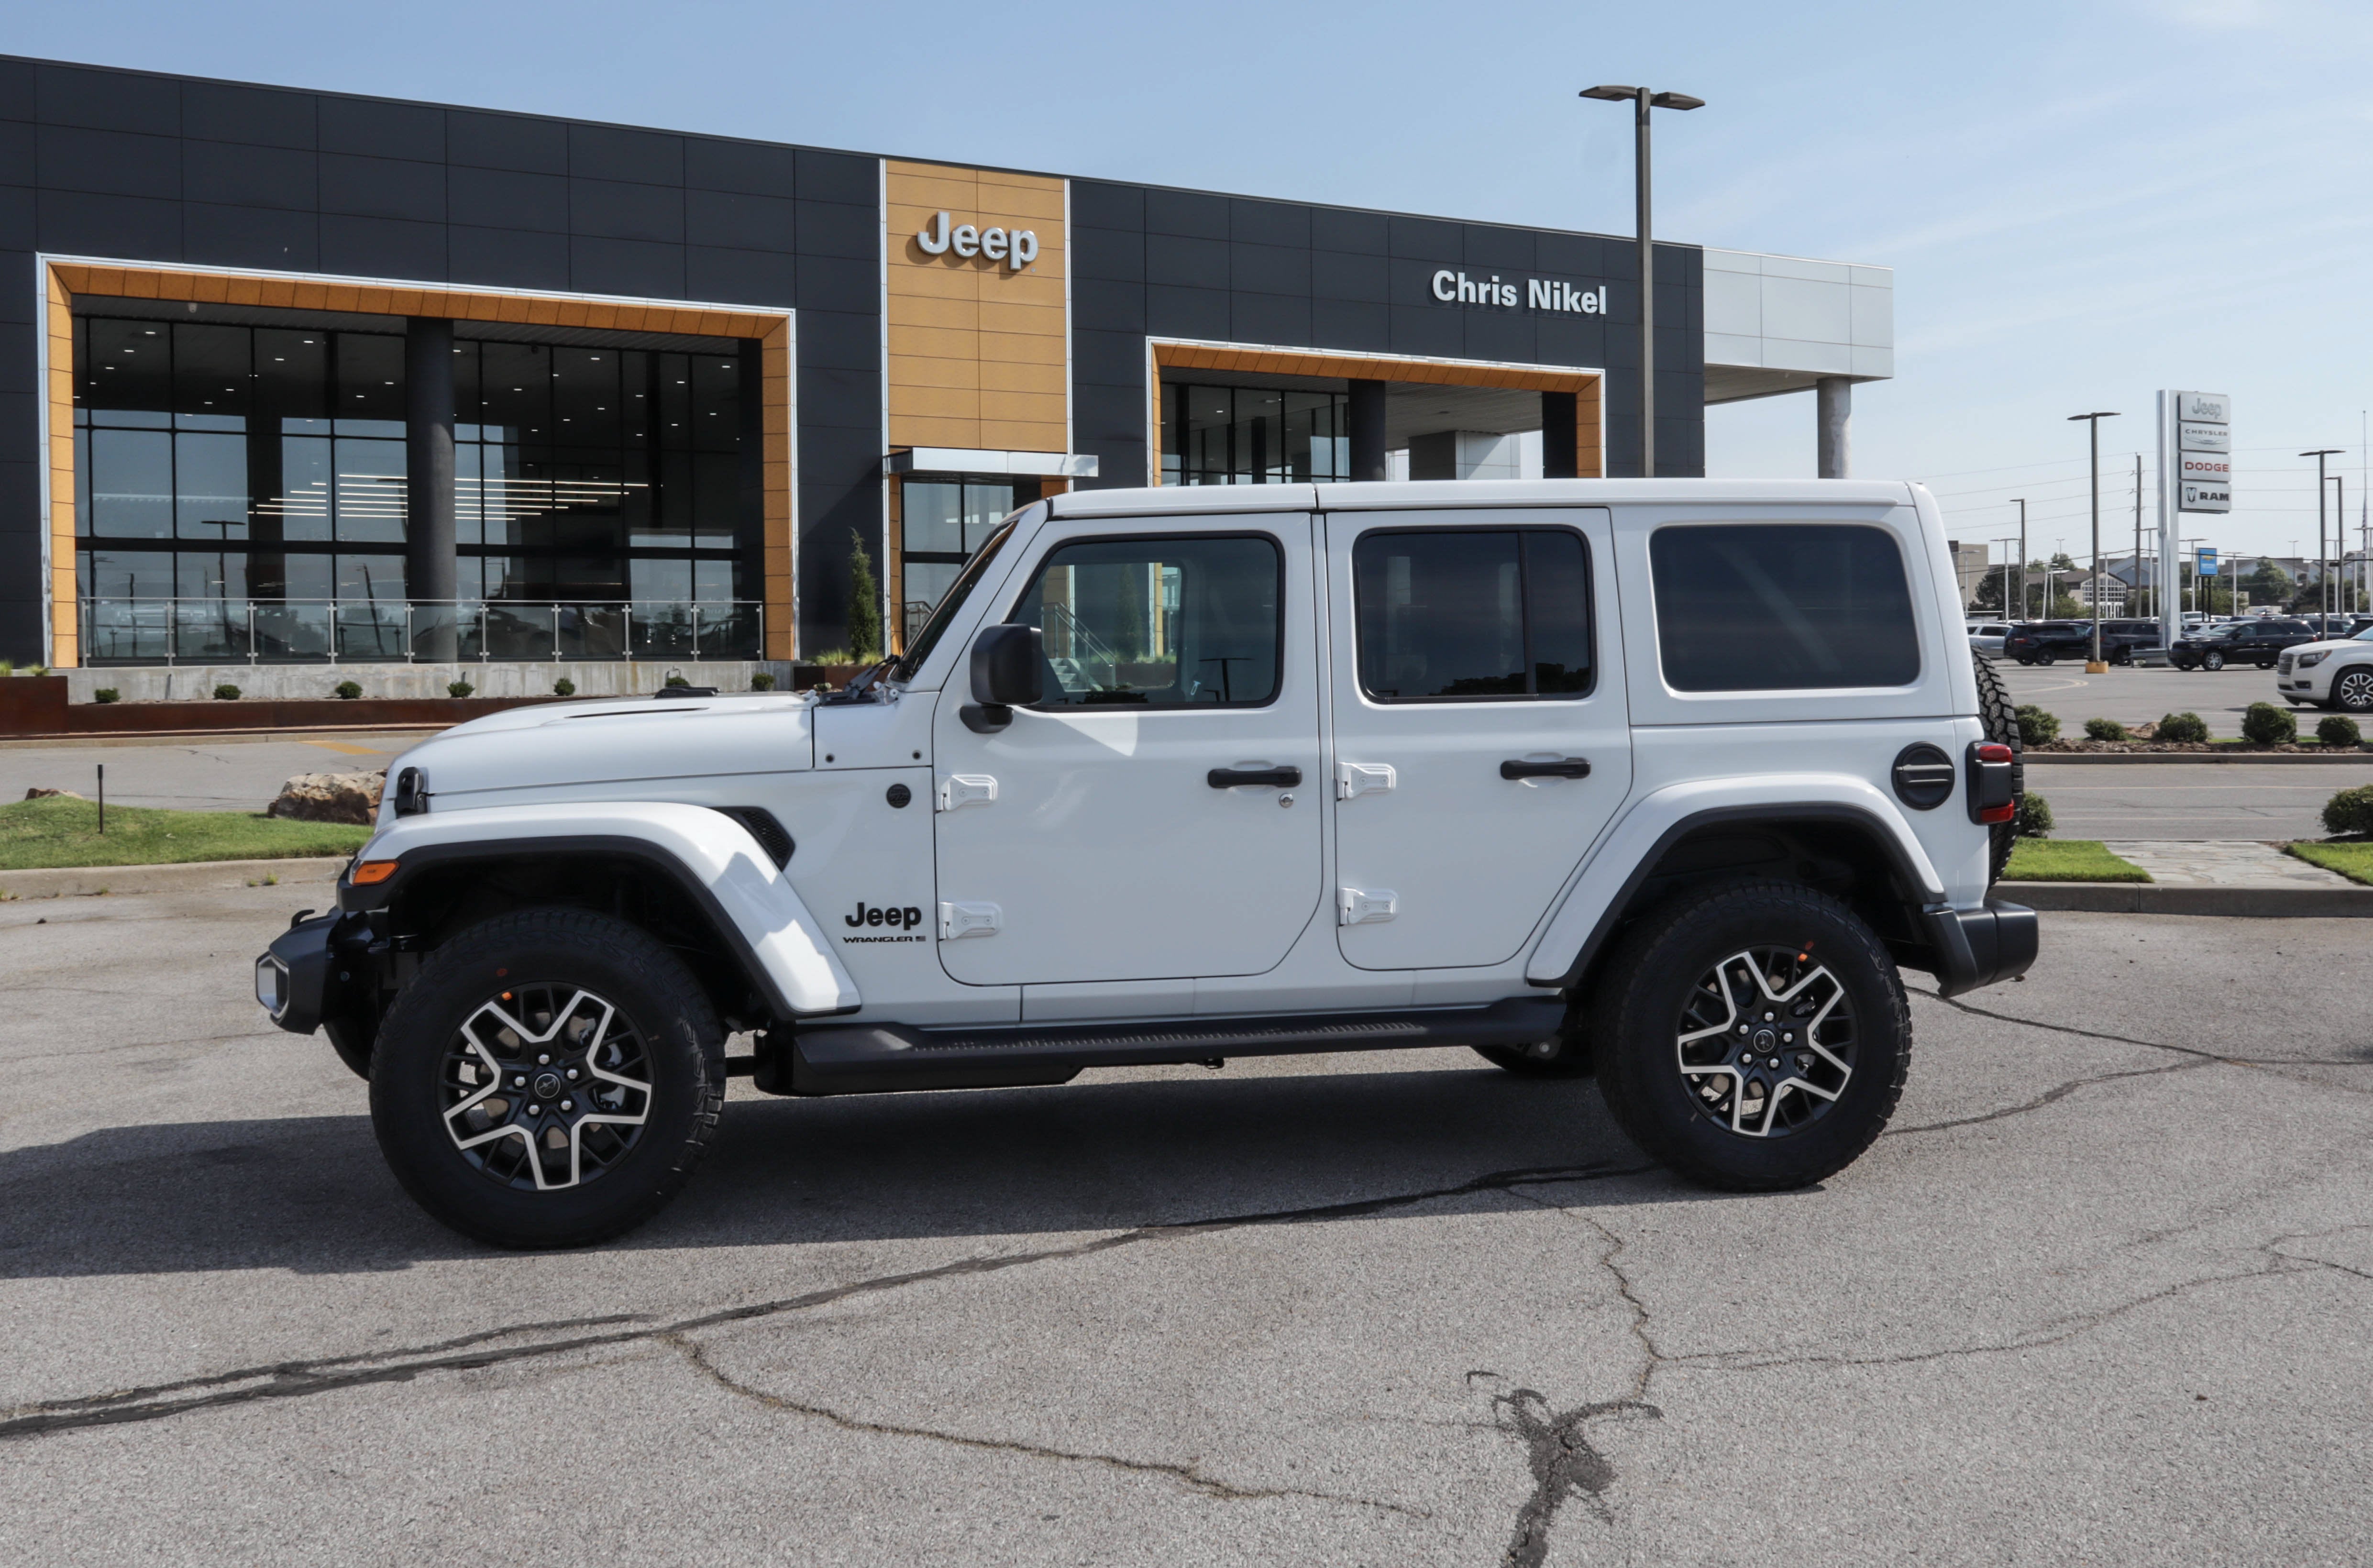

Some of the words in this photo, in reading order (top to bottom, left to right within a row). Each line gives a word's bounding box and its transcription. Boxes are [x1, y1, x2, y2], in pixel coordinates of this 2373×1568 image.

[917, 211, 1038, 270] Jeep
[1433, 270, 1517, 307] Chris
[1528, 279, 1607, 315] Nikel
[2192, 398, 2222, 419] Jeep
[2185, 462, 2229, 472] DODGE
[2199, 492, 2229, 501] RAM
[845, 902, 921, 930] Jeep
